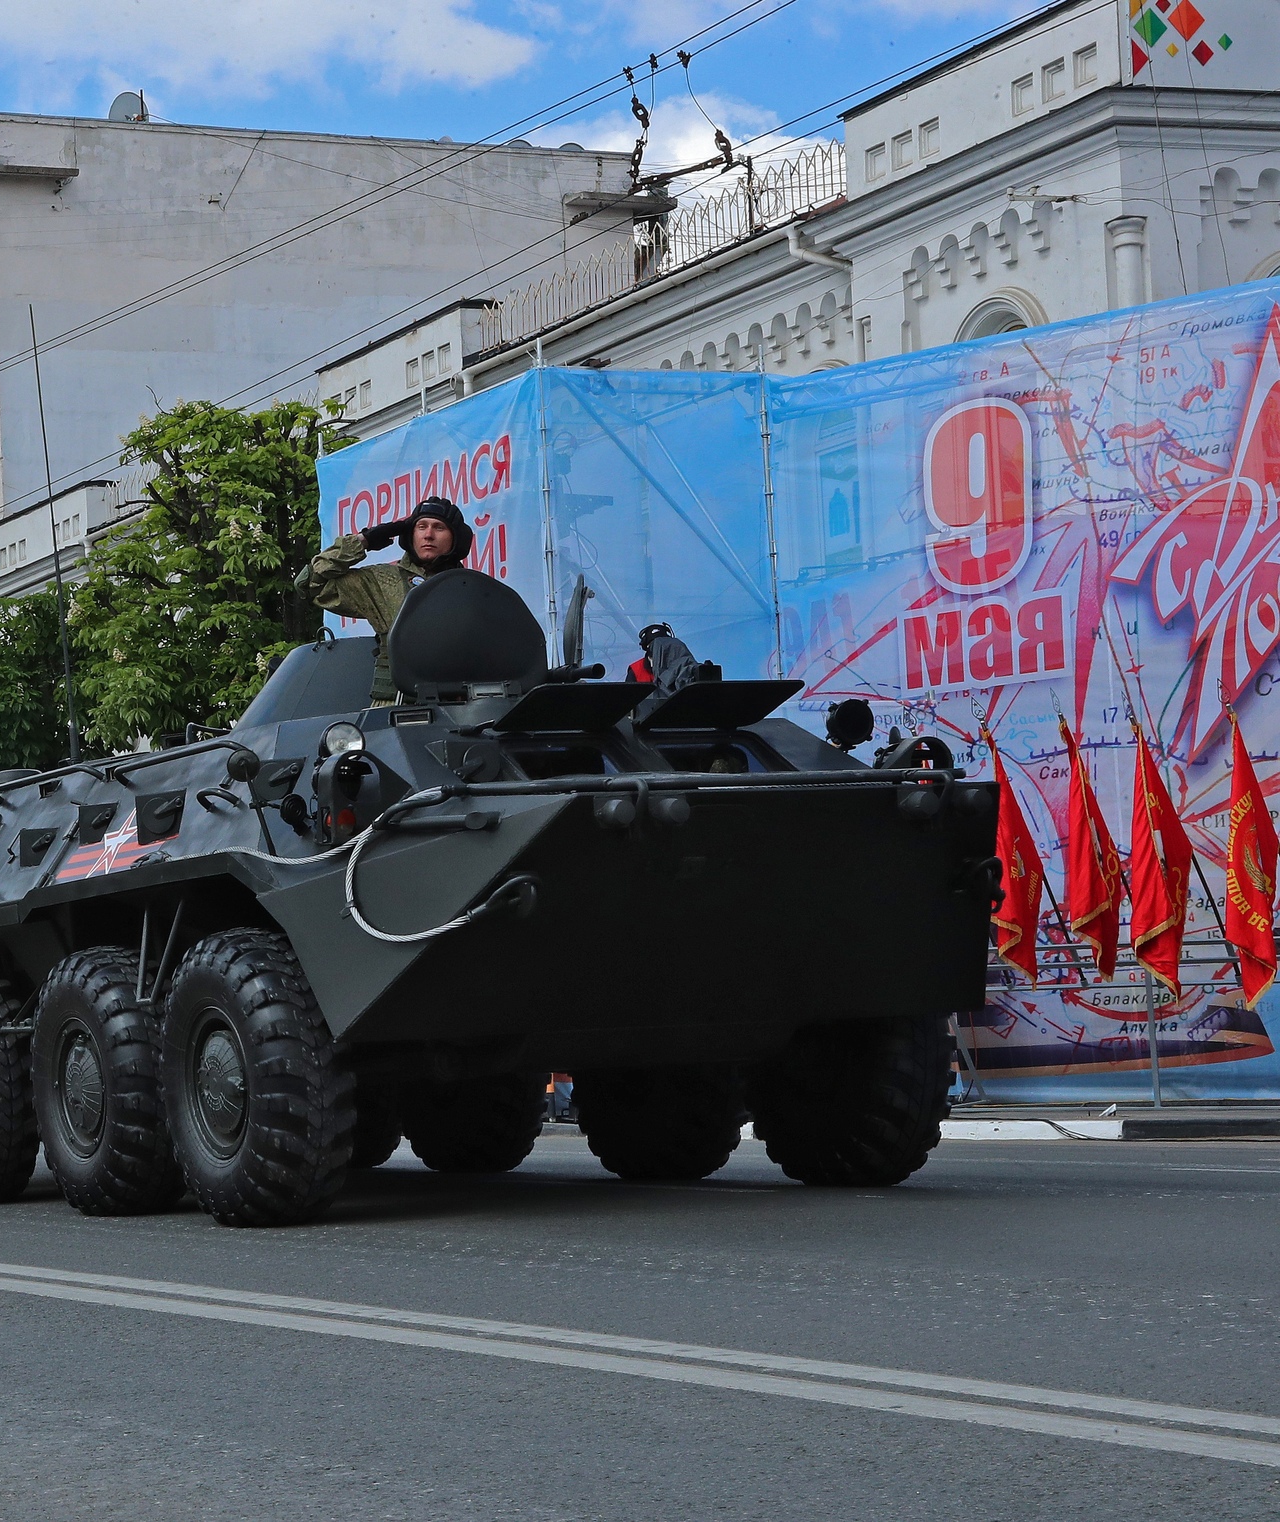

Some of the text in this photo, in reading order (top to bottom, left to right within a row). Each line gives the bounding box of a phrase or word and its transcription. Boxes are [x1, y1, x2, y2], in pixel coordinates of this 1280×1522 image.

[1181, 309, 1267, 337] Громовка
[1140, 346, 1155, 363] 51
[337, 434, 512, 536] ГОРДИМСЯ
[926, 400, 1032, 592] 9
[1098, 502, 1157, 522] Воинка
[1099, 530, 1119, 548] 49
[903, 595, 1067, 691] мая
[1103, 707, 1118, 723] 17
[1039, 765, 1070, 780] Сак
[1247, 911, 1270, 933] ЗА
[1118, 1020, 1178, 1035] Алука
